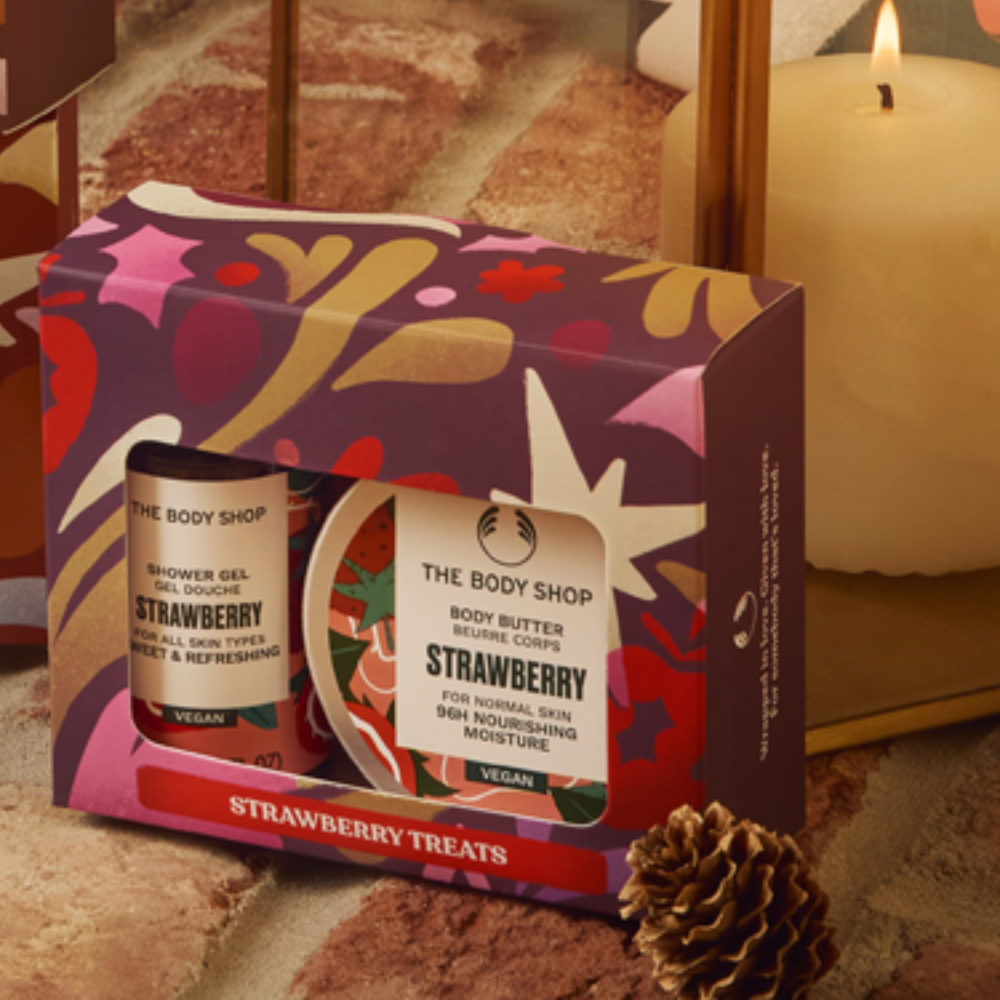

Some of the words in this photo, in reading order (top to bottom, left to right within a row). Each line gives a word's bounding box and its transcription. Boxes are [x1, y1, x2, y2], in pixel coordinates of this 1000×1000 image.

[131, 500, 161, 521] THE
[166, 508, 214, 526] BODY
[218, 506, 267, 526] SHOP
[146, 562, 214, 582] SHOWER
[218, 568, 250, 582] GEL
[421, 562, 463, 587] THE
[471, 570, 528, 597] BODY
[533, 581, 593, 606] SHOP
[154, 581, 179, 594] GEL
[184, 583, 241, 596] DOUCHE
[135, 594, 263, 630] STRAWBERRY
[450, 605, 494, 624] BODY
[498, 614, 564, 637] BUTTER
[133, 626, 158, 643] FOR
[161, 634, 185, 648] ALL
[189, 637, 221, 649] SKIN
[225, 634, 266, 648] TYPES
[453, 624, 509, 645] BEURRE
[513, 634, 561, 653] CORPS
[130, 640, 167, 660] WEET
[171, 650, 181, 662] &
[186, 645, 280, 665] REFRESHING
[426, 642, 587, 701] STRAWBERRY
[173, 710, 226, 724] VEGAN
[442, 690, 470, 705] FOR
[474, 696, 534, 718] NORMAL
[538, 706, 572, 723] SKIN
[436, 704, 467, 722] 96H
[474, 711, 577, 741] NOURISHING
[463, 726, 550, 752] MOISTURE
[480, 766, 534, 788] VEGAN
[229, 795, 404, 847] STRAWBERRY
[407, 830, 508, 866] TREATS
